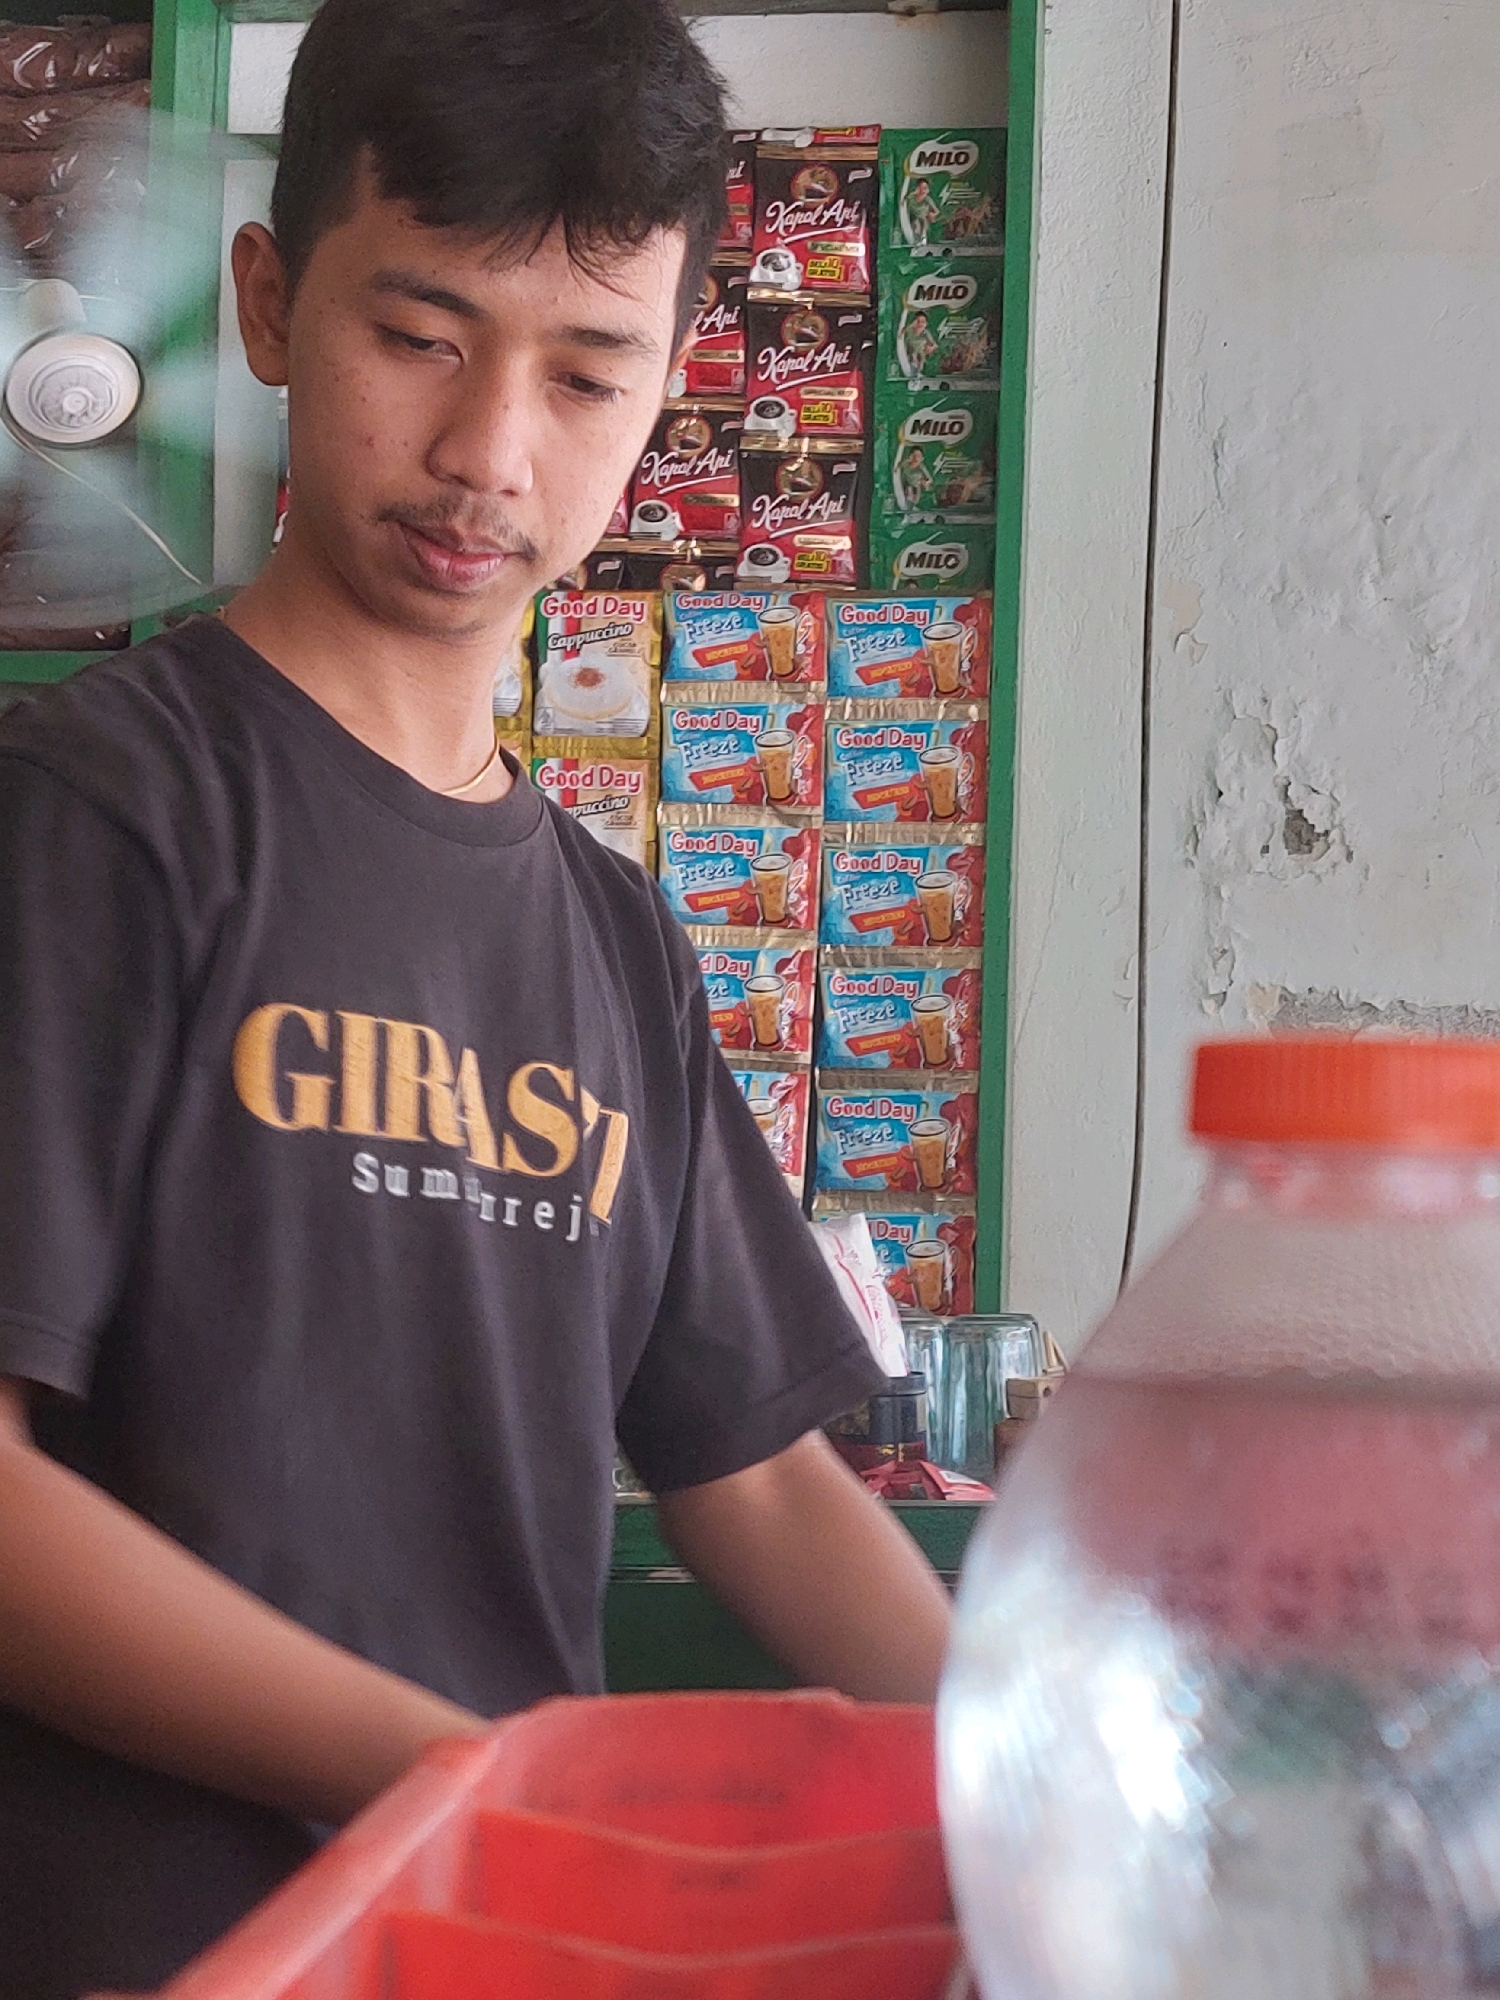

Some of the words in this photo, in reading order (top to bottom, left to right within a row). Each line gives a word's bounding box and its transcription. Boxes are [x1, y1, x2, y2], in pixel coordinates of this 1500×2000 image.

[727, 160, 746, 182] pi
[915, 151, 970, 168] MILO
[765, 200, 822, 236] Kapal
[820, 198, 861, 227] Api
[913, 284, 969, 301] MILO
[701, 303, 740, 332] Api
[757, 345, 815, 384] Kapal
[811, 342, 852, 372] Api
[909, 419, 965, 436] MILO
[641, 451, 696, 488] Kapal
[694, 447, 734, 476] Api
[752, 494, 810, 532] Kapal
[806, 492, 847, 521] Api
[905, 551, 961, 570] MILO
[543, 596, 598, 616] Good
[603, 597, 645, 621] Day
[678, 592, 726, 609] Good
[727, 593, 765, 612] Day
[840, 604, 888, 624] Good
[891, 604, 929, 627] Day
[548, 622, 633, 652] Cappuccino
[681, 614, 742, 645] Freeze
[846, 629, 906, 663] Freeze
[675, 710, 722, 730] Good
[725, 710, 762, 734] Day
[679, 735, 740, 768] Freeze
[838, 728, 886, 748] Good
[888, 728, 925, 751] Day
[539, 765, 594, 787] Good
[599, 766, 641, 793] Day
[844, 753, 903, 786] Freeze
[671, 832, 718, 851] Good
[721, 833, 758, 858] Day
[674, 858, 735, 890] Freeze
[835, 851, 882, 872] Good
[885, 852, 922, 876] Day
[840, 876, 900, 911] Freeze
[715, 954, 751, 979] Day
[831, 975, 879, 995] Good
[882, 976, 919, 999] Day
[835, 1000, 896, 1034] Freeze
[828, 1097, 875, 1118] Good
[879, 1098, 916, 1123] Day
[833, 1122, 893, 1156] Freeze
[875, 1219, 912, 1245] Day
